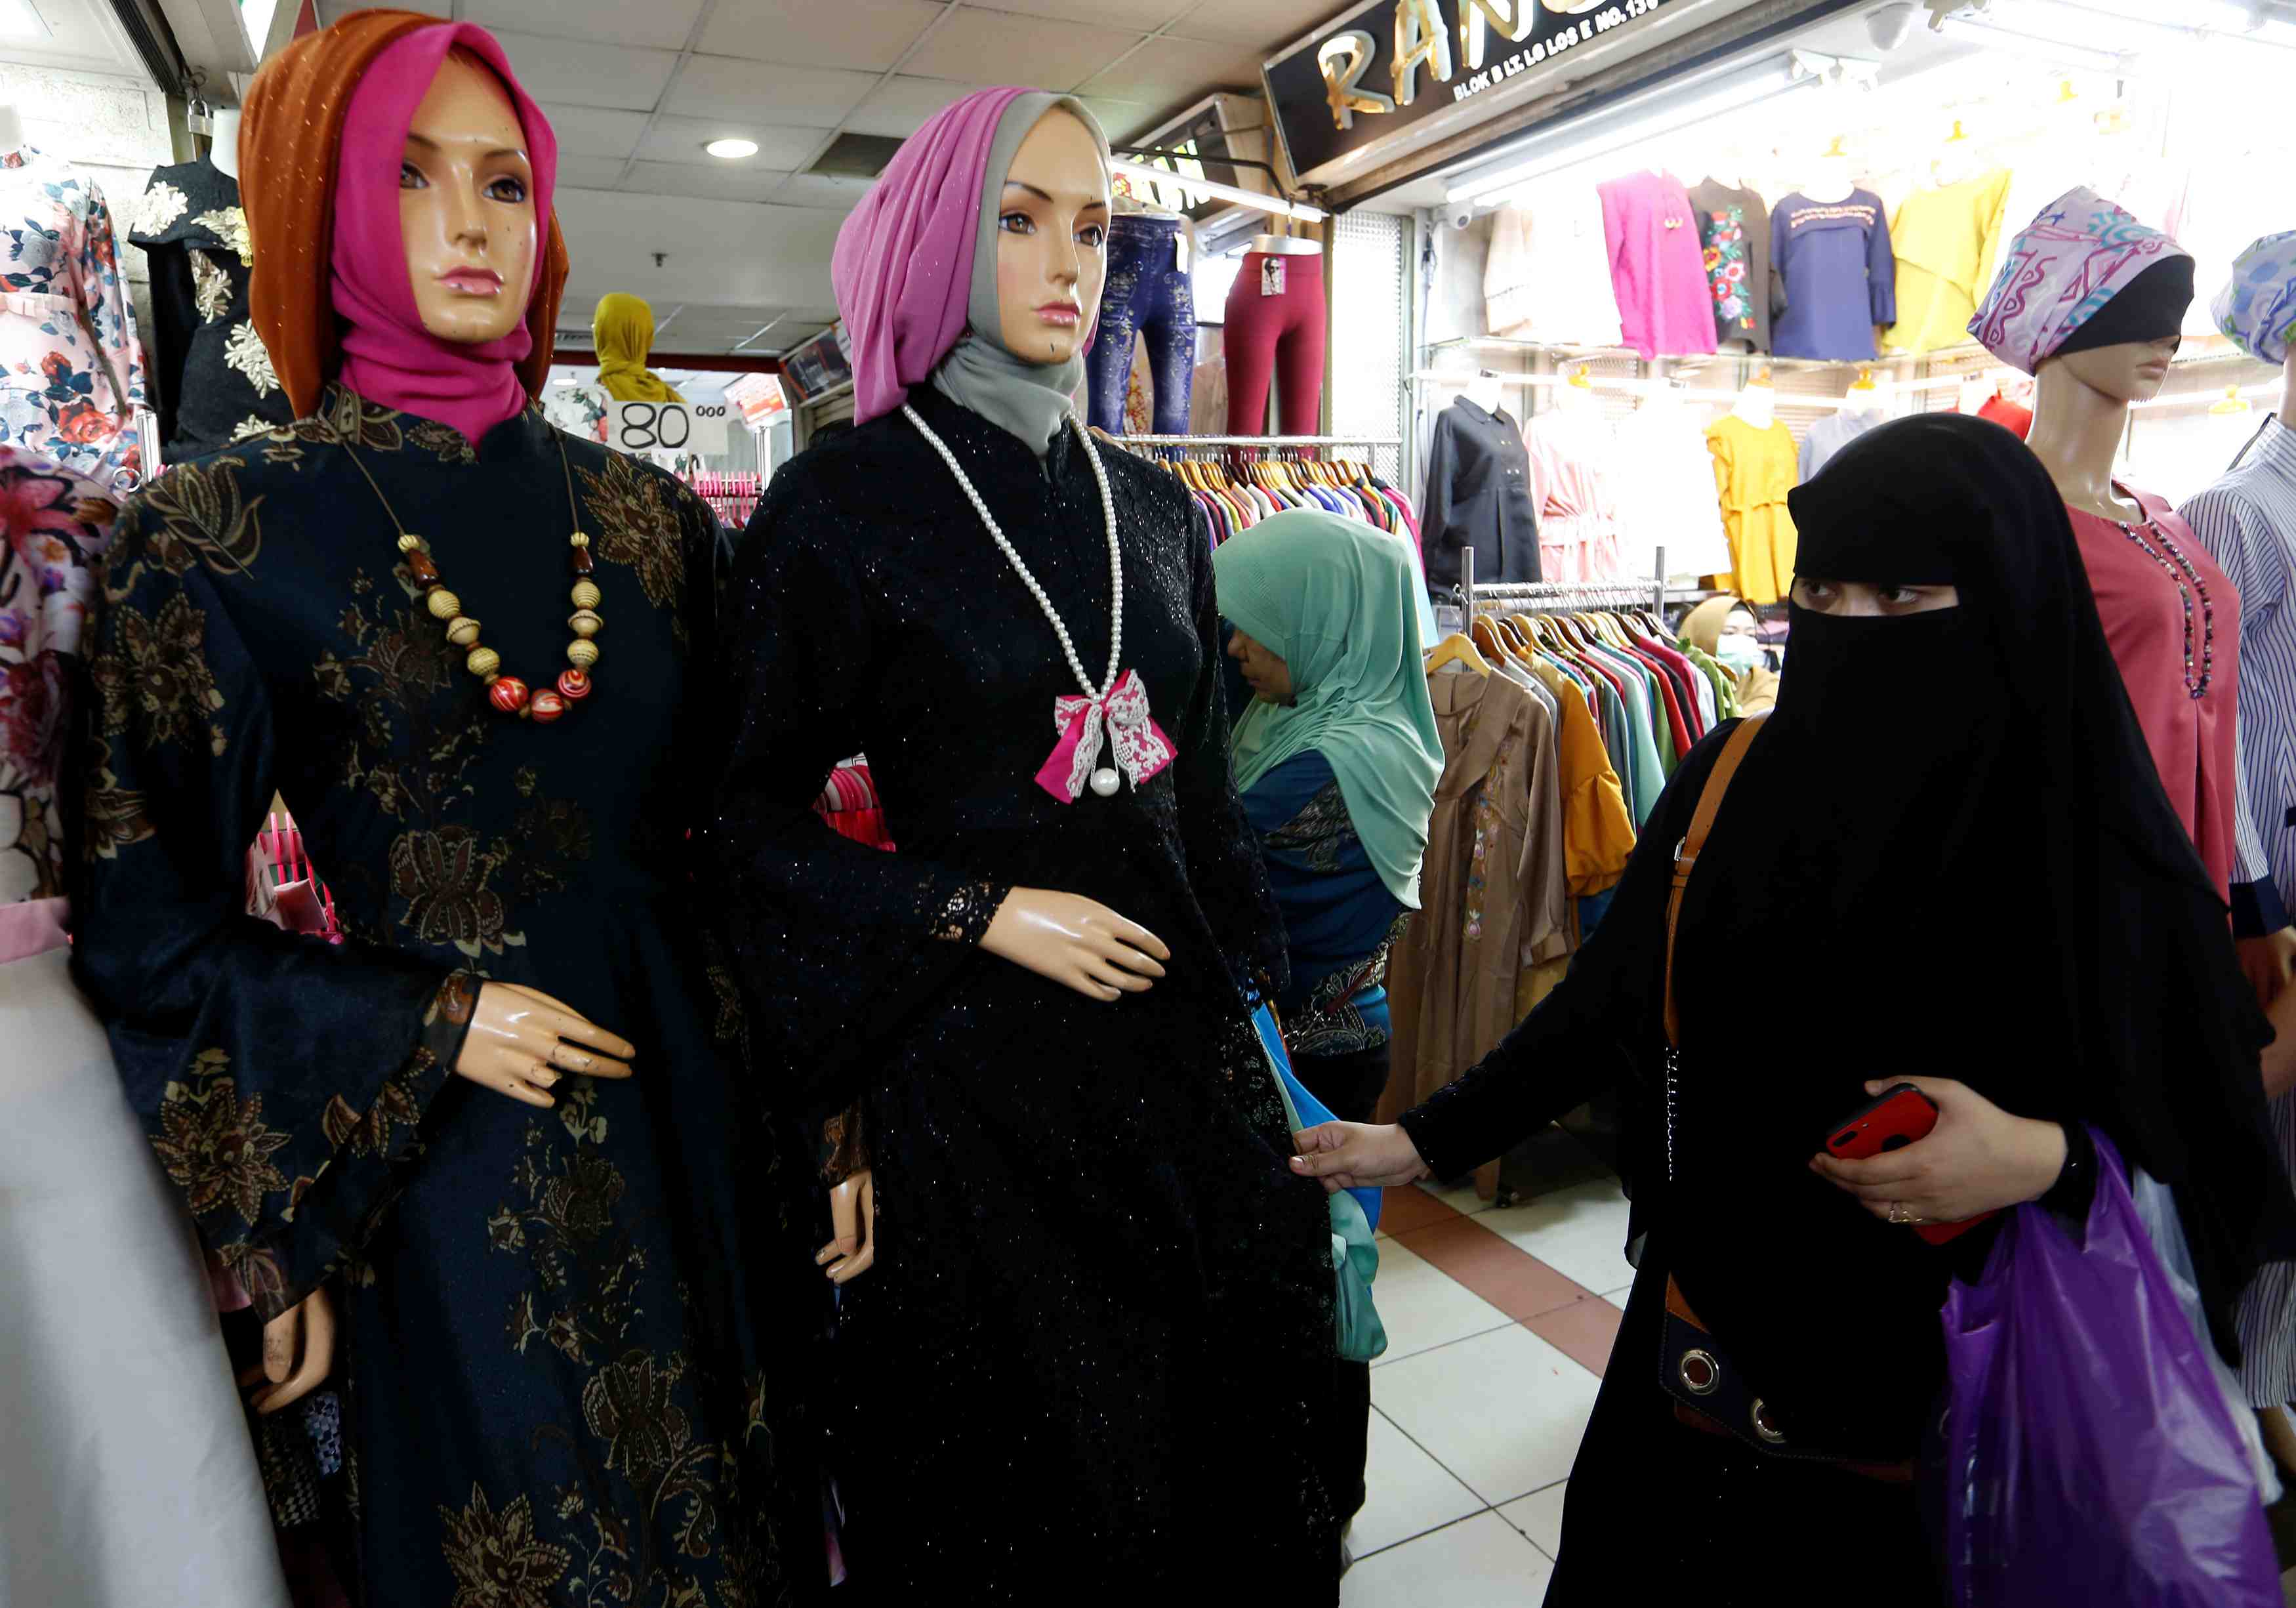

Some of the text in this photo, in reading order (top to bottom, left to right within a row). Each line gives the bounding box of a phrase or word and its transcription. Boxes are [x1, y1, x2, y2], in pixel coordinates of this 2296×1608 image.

[1317, 0, 1607, 130] RAN
[1452, 71, 1491, 102] BLOK
[1490, 64, 1504, 83] B
[1546, 26, 1579, 56] LOS
[1579, 19, 1593, 40] E
[621, 402, 726, 449] 80 000
